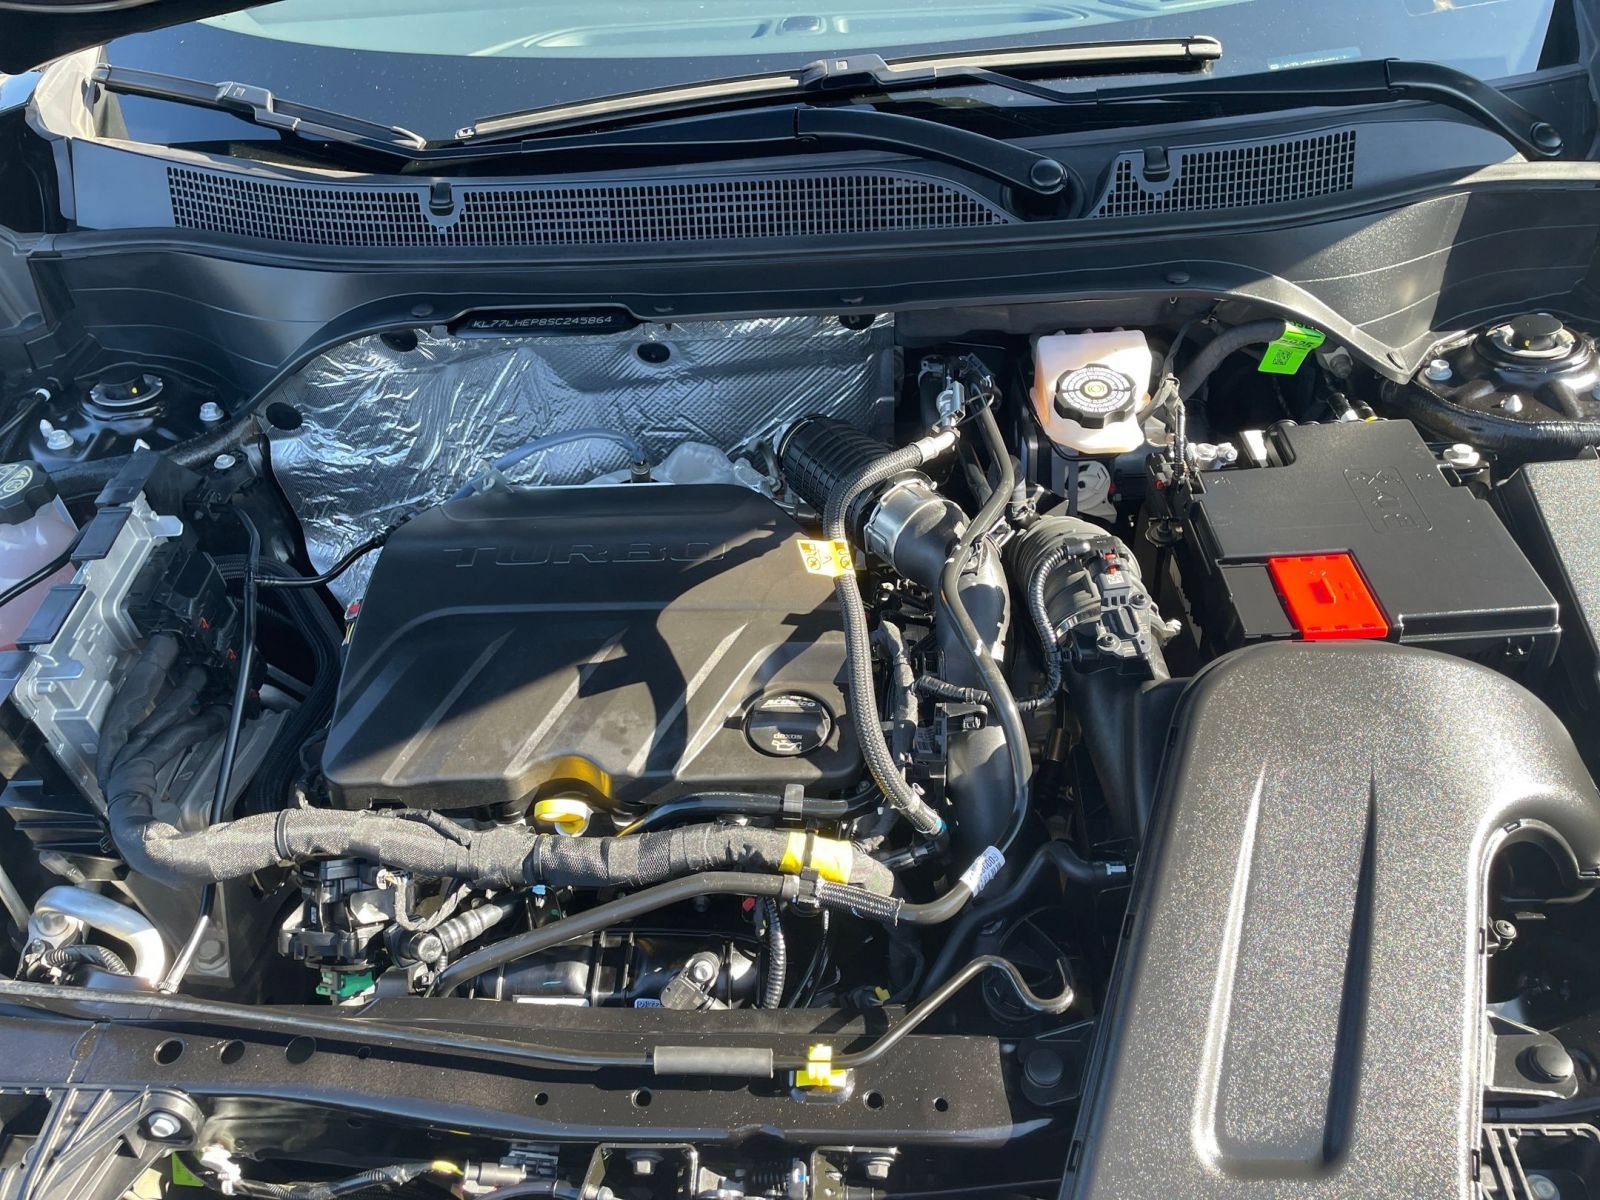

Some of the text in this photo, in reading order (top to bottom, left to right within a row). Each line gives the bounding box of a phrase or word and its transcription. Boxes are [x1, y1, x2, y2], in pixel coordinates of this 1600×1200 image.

[472, 316, 612, 328] KL77LHEP8SC245864
[443, 542, 726, 567] TURBO
[773, 732, 803, 740] dexos
